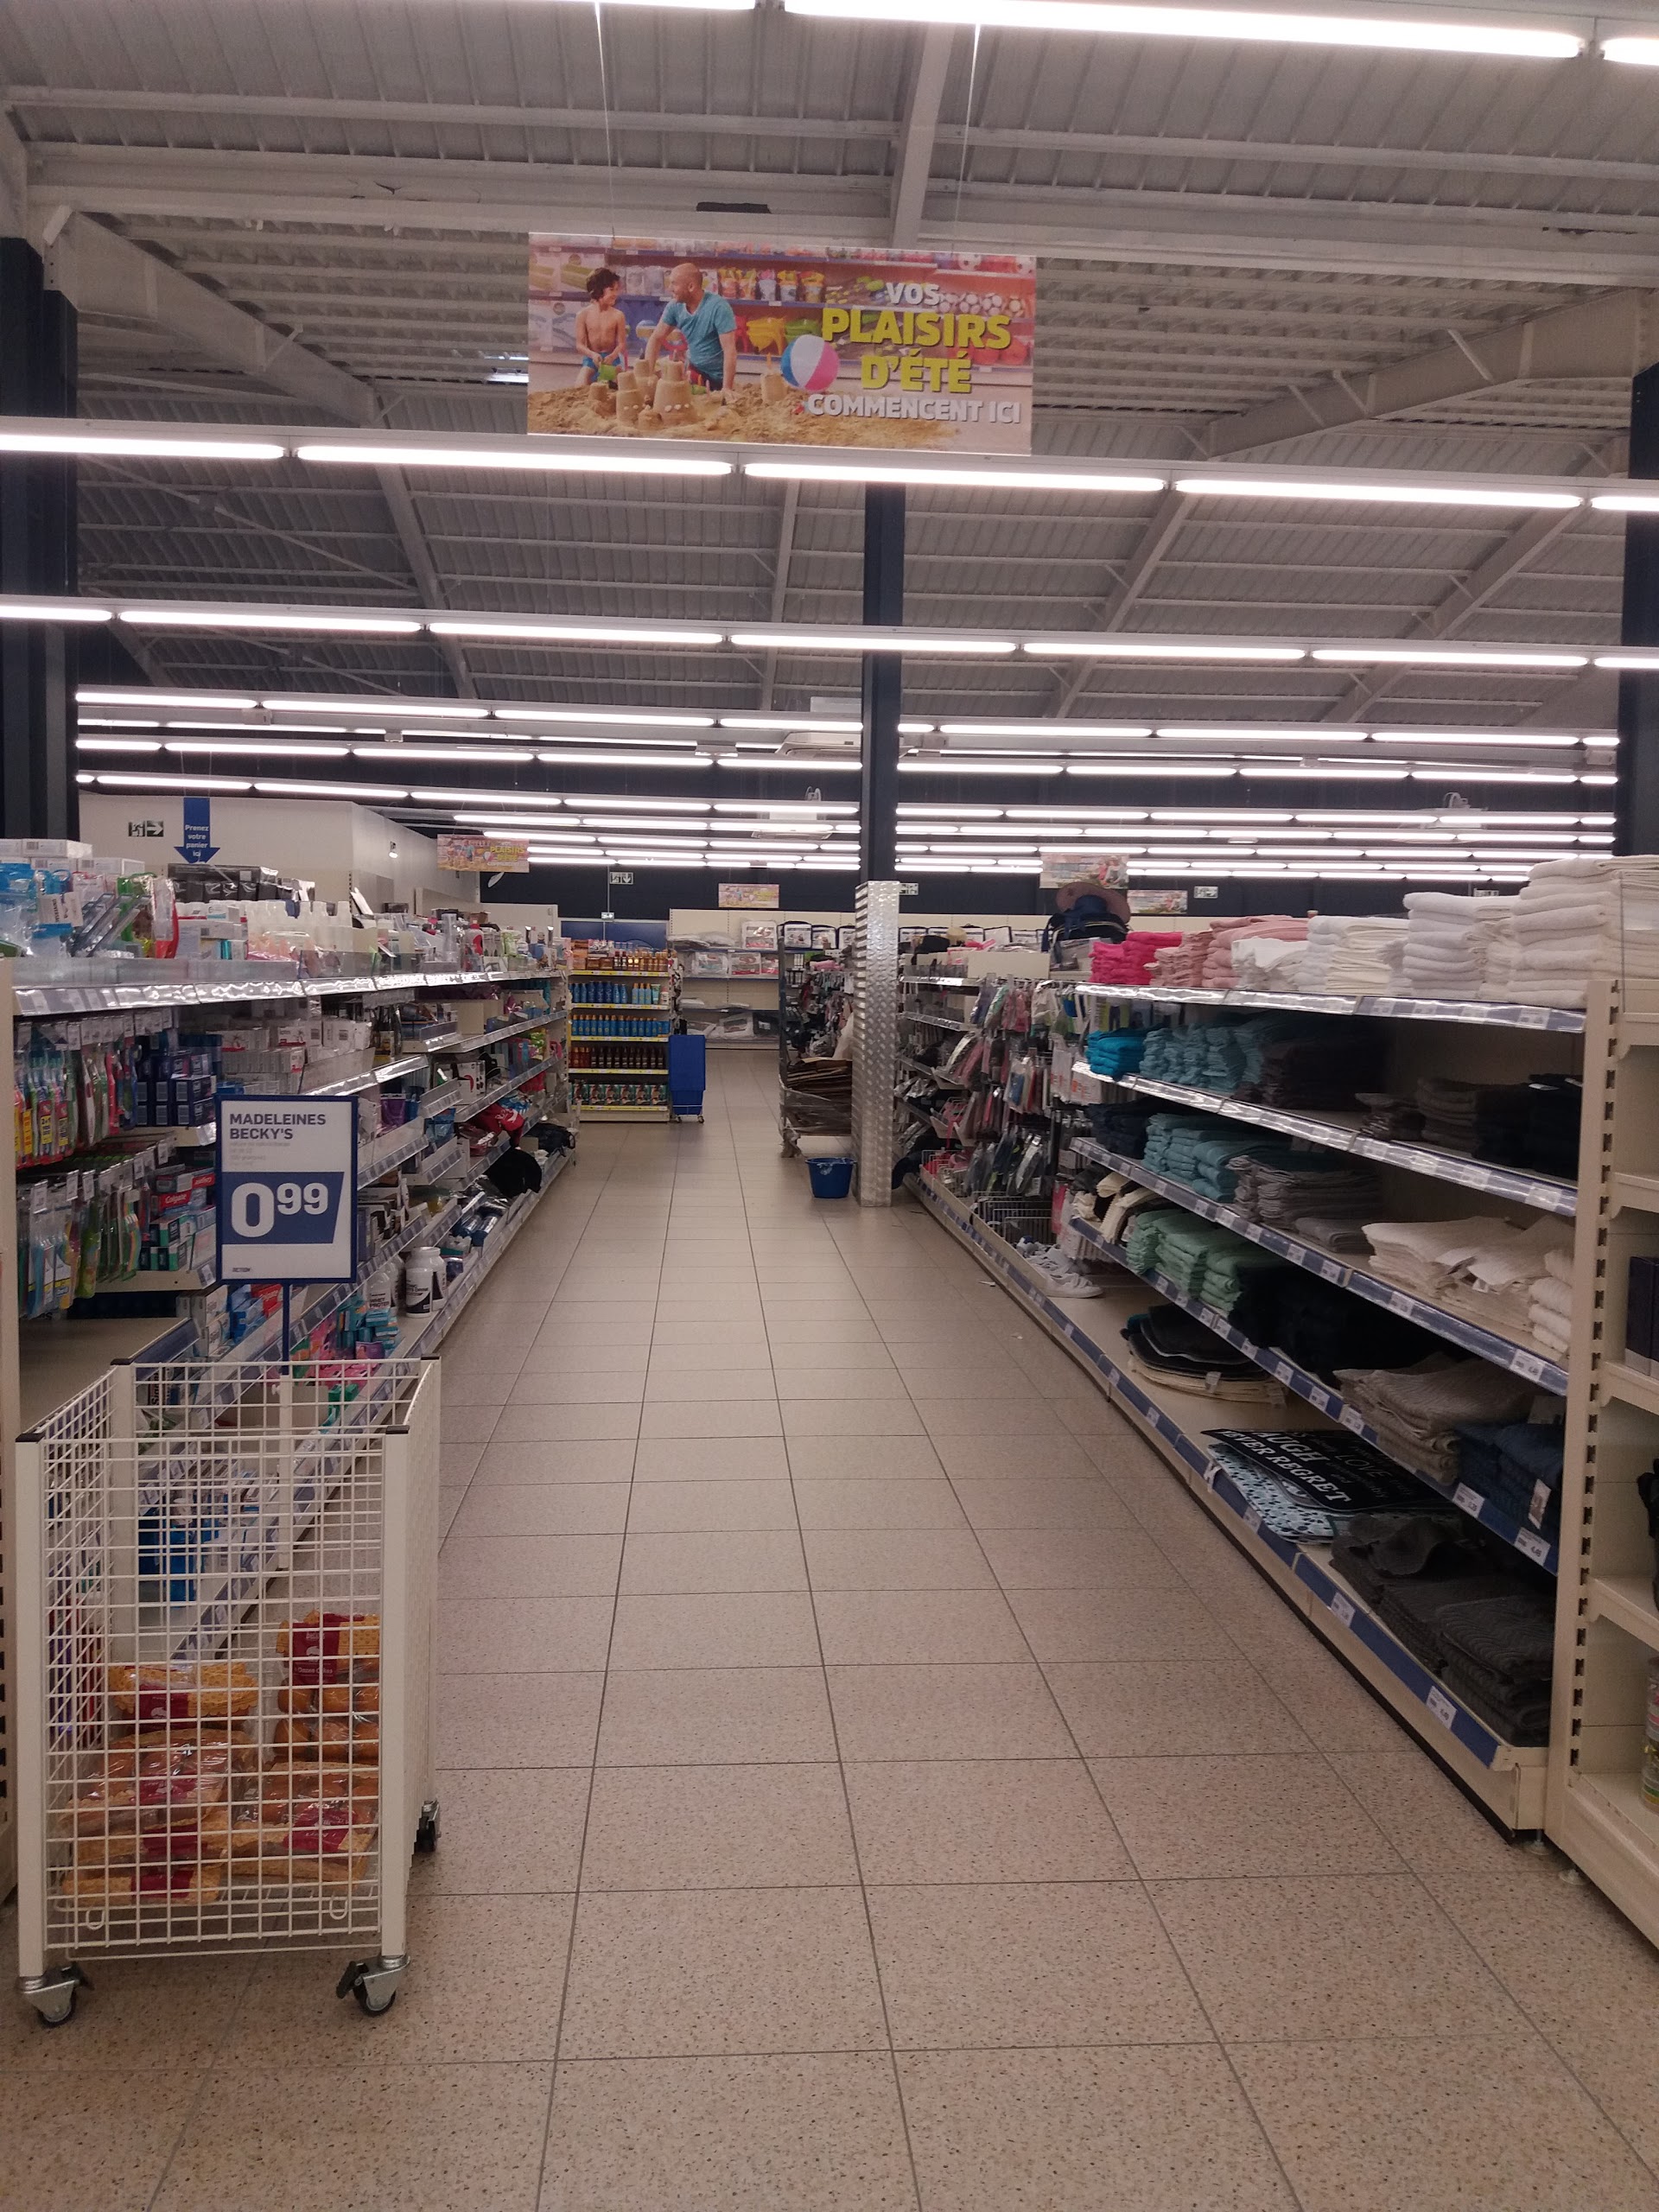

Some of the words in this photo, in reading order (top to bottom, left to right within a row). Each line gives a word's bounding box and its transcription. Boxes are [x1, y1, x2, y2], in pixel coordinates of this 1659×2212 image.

[886, 282, 940, 308] VOS
[822, 308, 1013, 350] PLAISIRS
[861, 346, 973, 393] D'ÉTÉ
[807, 393, 985, 423] COMMENCENT
[988, 400, 1021, 424] ICI
[230, 1114, 326, 1125] MADELEINES
[230, 1128, 294, 1140] BECKY'S
[164, 1192, 188, 1205] Colgate
[1265, 1456, 1352, 1502] REGRET
